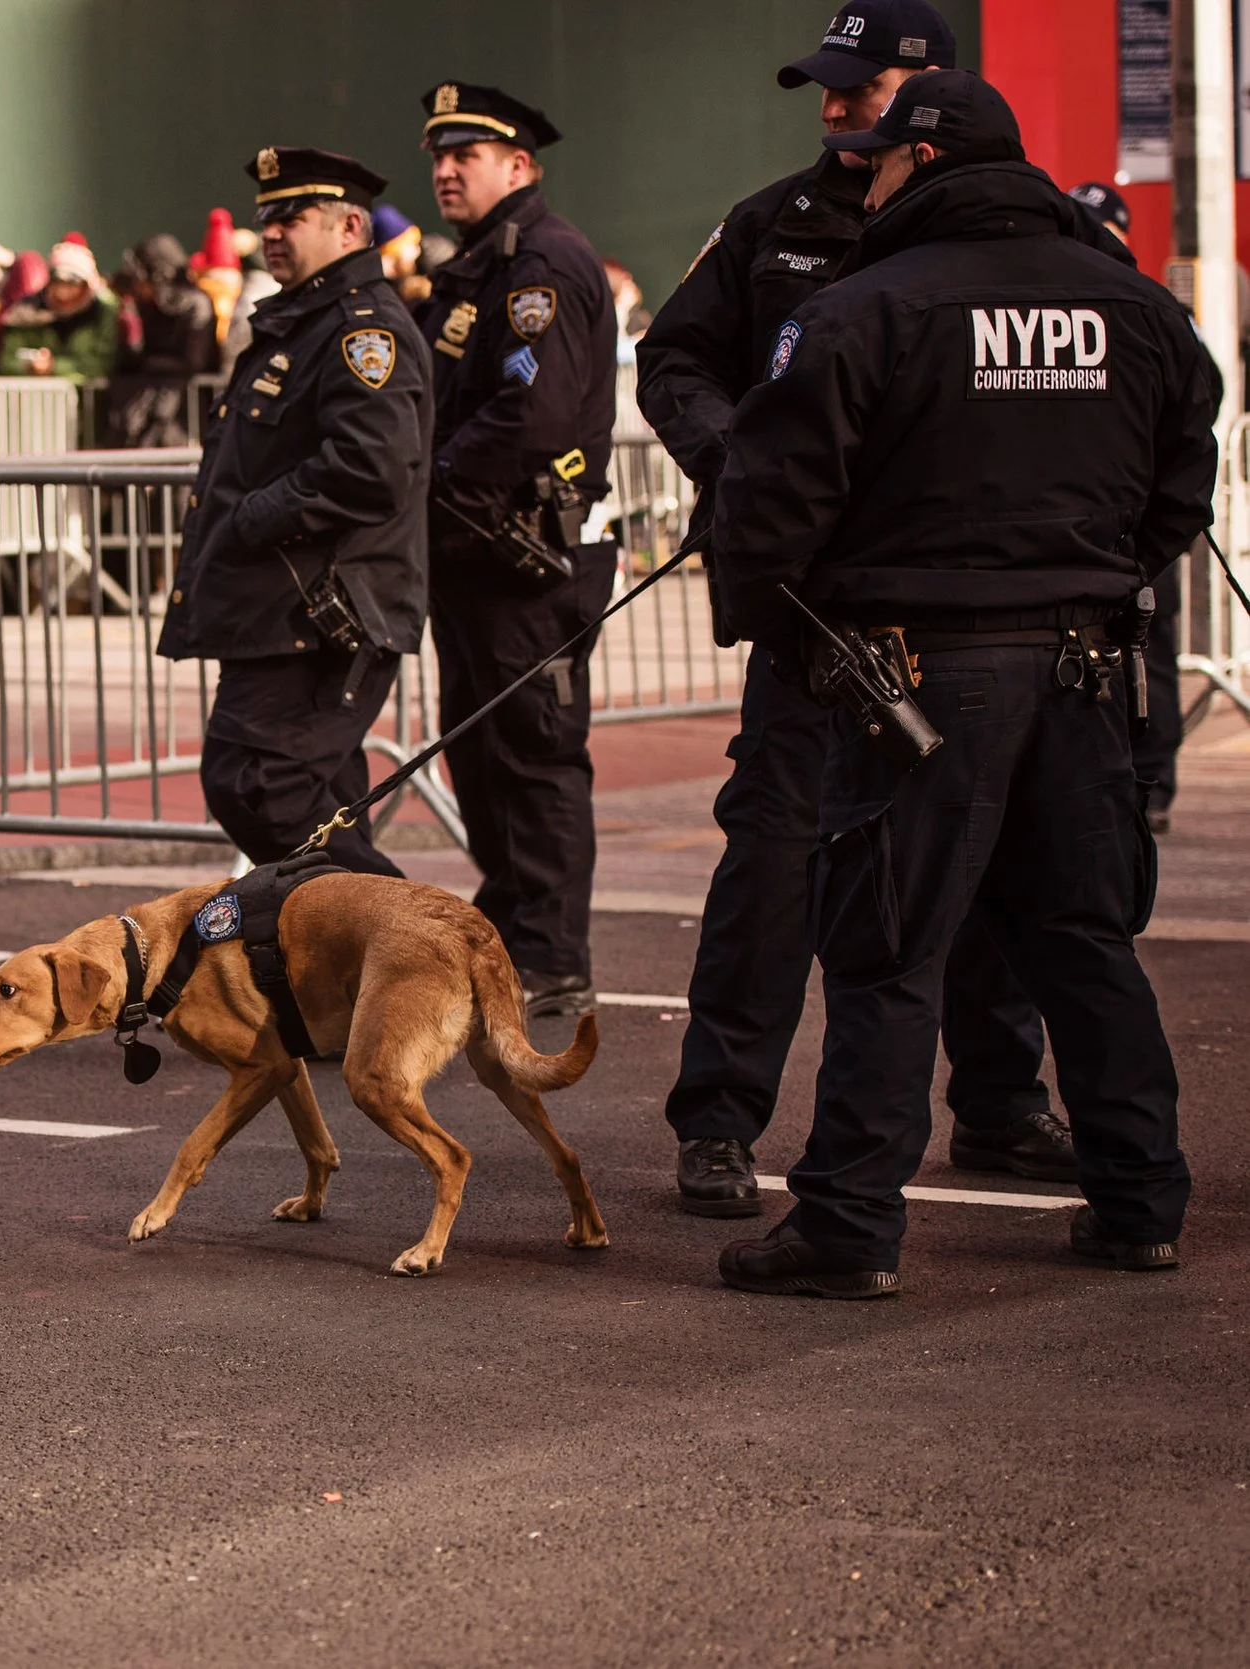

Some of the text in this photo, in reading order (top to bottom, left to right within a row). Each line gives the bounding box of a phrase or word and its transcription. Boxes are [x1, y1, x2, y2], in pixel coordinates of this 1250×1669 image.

[777, 251, 828, 266] KENNEDY
[971, 308, 1107, 367] NYPD
[974, 369, 1107, 390] COUNTERTERRORISM
